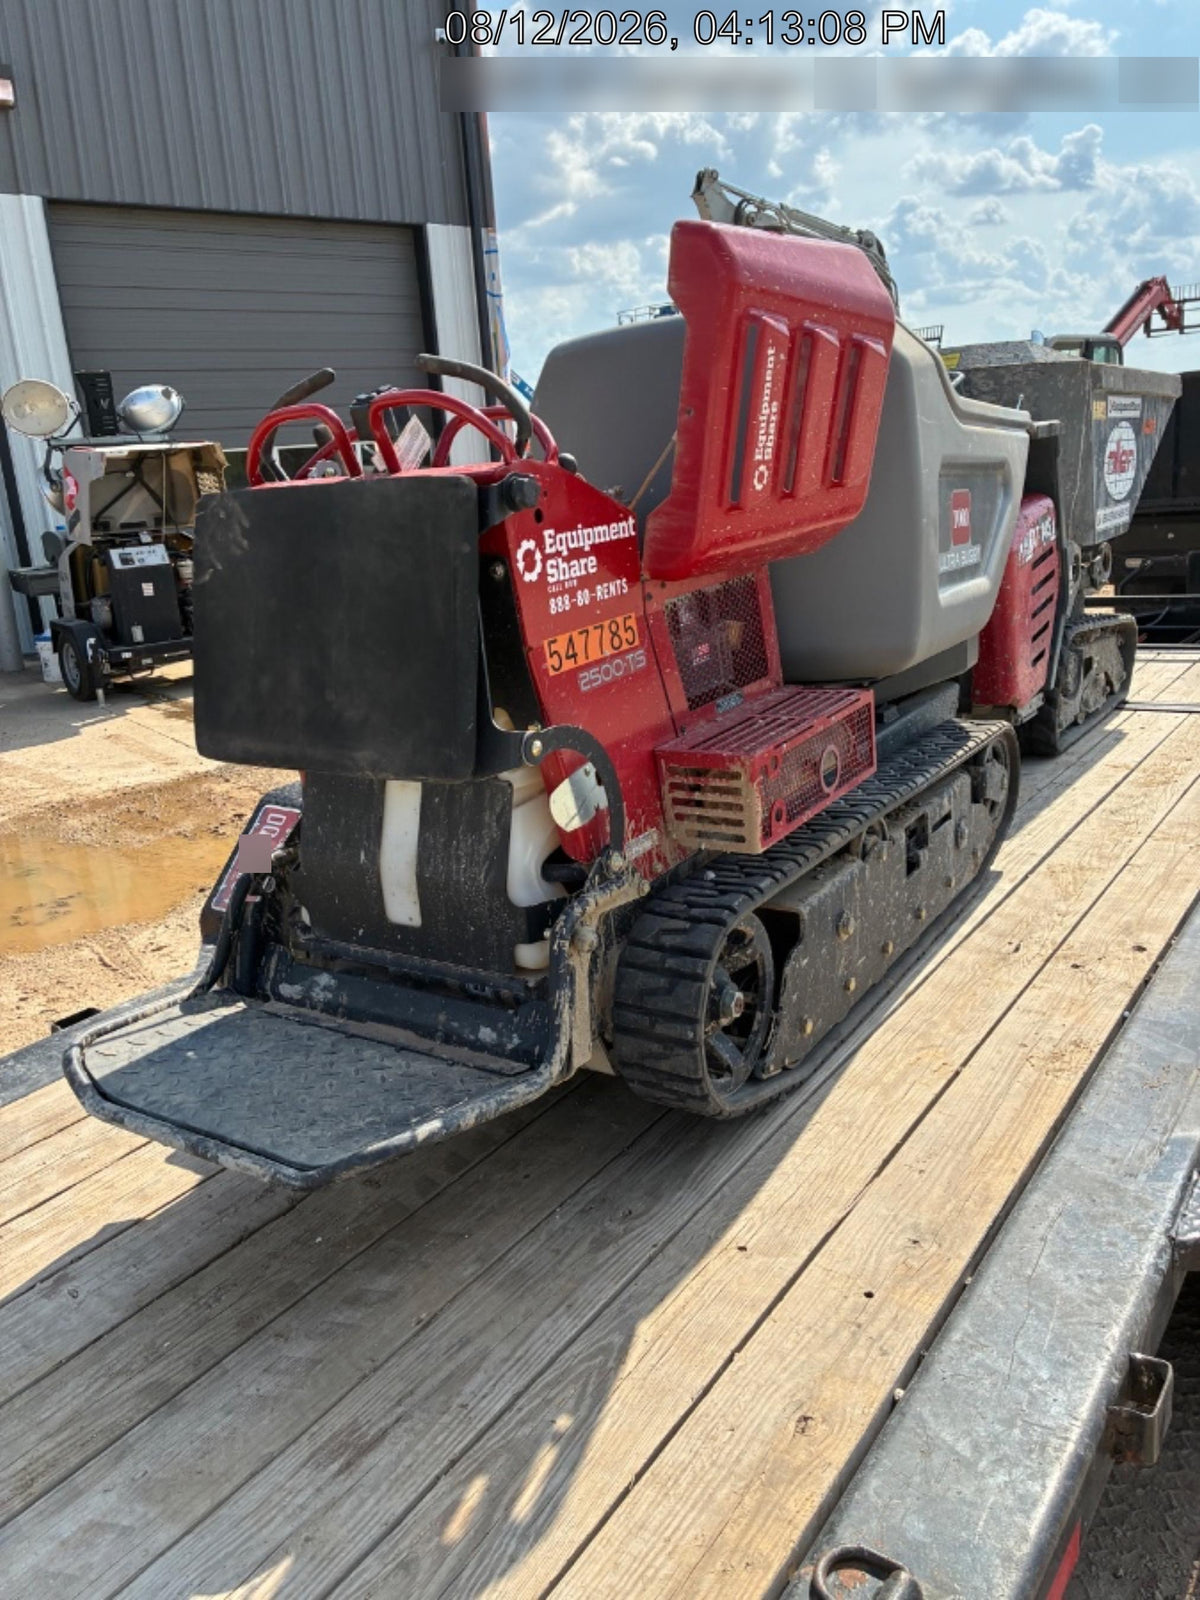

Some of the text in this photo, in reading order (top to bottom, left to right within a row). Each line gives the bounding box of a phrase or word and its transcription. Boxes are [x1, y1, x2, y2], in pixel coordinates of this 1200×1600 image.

[543, 515, 636, 556] Equipment
[546, 555, 598, 583] Share
[549, 577, 629, 615] 888-80-RENTS
[547, 615, 636, 673] 547785
